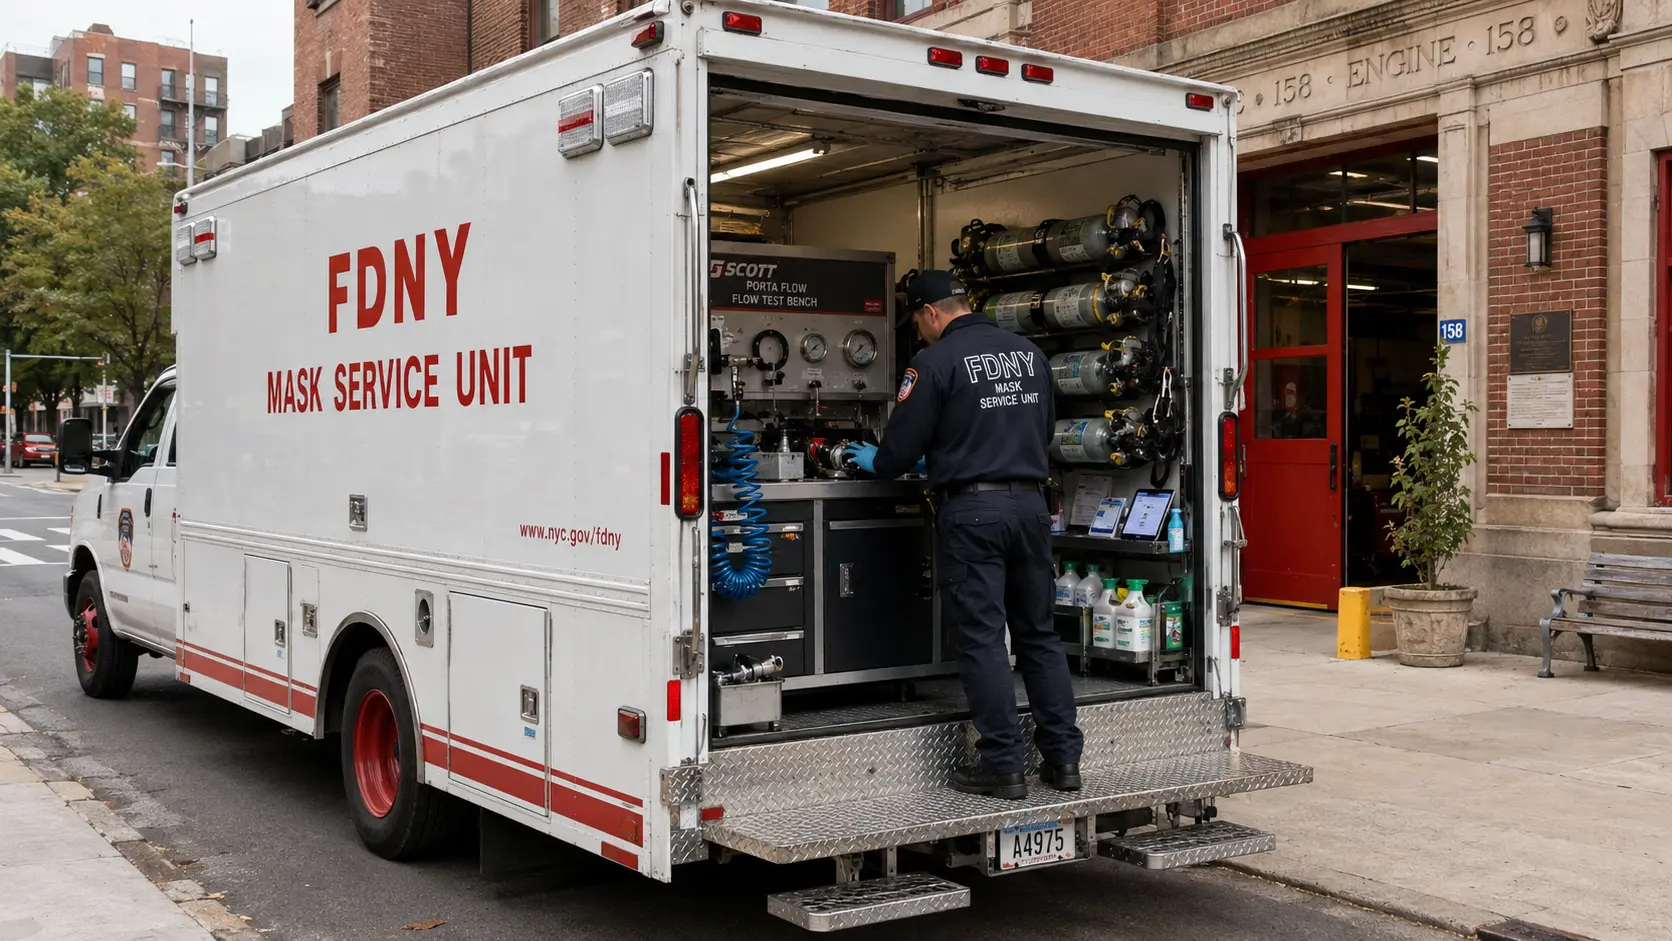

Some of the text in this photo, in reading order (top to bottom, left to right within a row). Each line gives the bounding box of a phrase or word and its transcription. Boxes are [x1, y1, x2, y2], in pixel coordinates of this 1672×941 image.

[1274, 73, 1312, 107] 158
[1347, 35, 1456, 88] ENGINE
[1486, 16, 1536, 56] 158
[328, 222, 471, 334] FDNY
[725, 262, 777, 278] SCOTT
[746, 280, 807, 293] PORTA FLOW
[732, 293, 818, 307] FLOW TEST BENCH
[1441, 322, 1463, 339] 158
[963, 351, 1034, 384] FDNY
[267, 344, 532, 414] MASK SERVICE UNIT
[994, 381, 1023, 394] MASK
[980, 392, 1039, 409] SERVICE UNIT
[519, 524, 622, 551] www.nyc.gov/fdny
[1013, 828, 1064, 859] A4975
